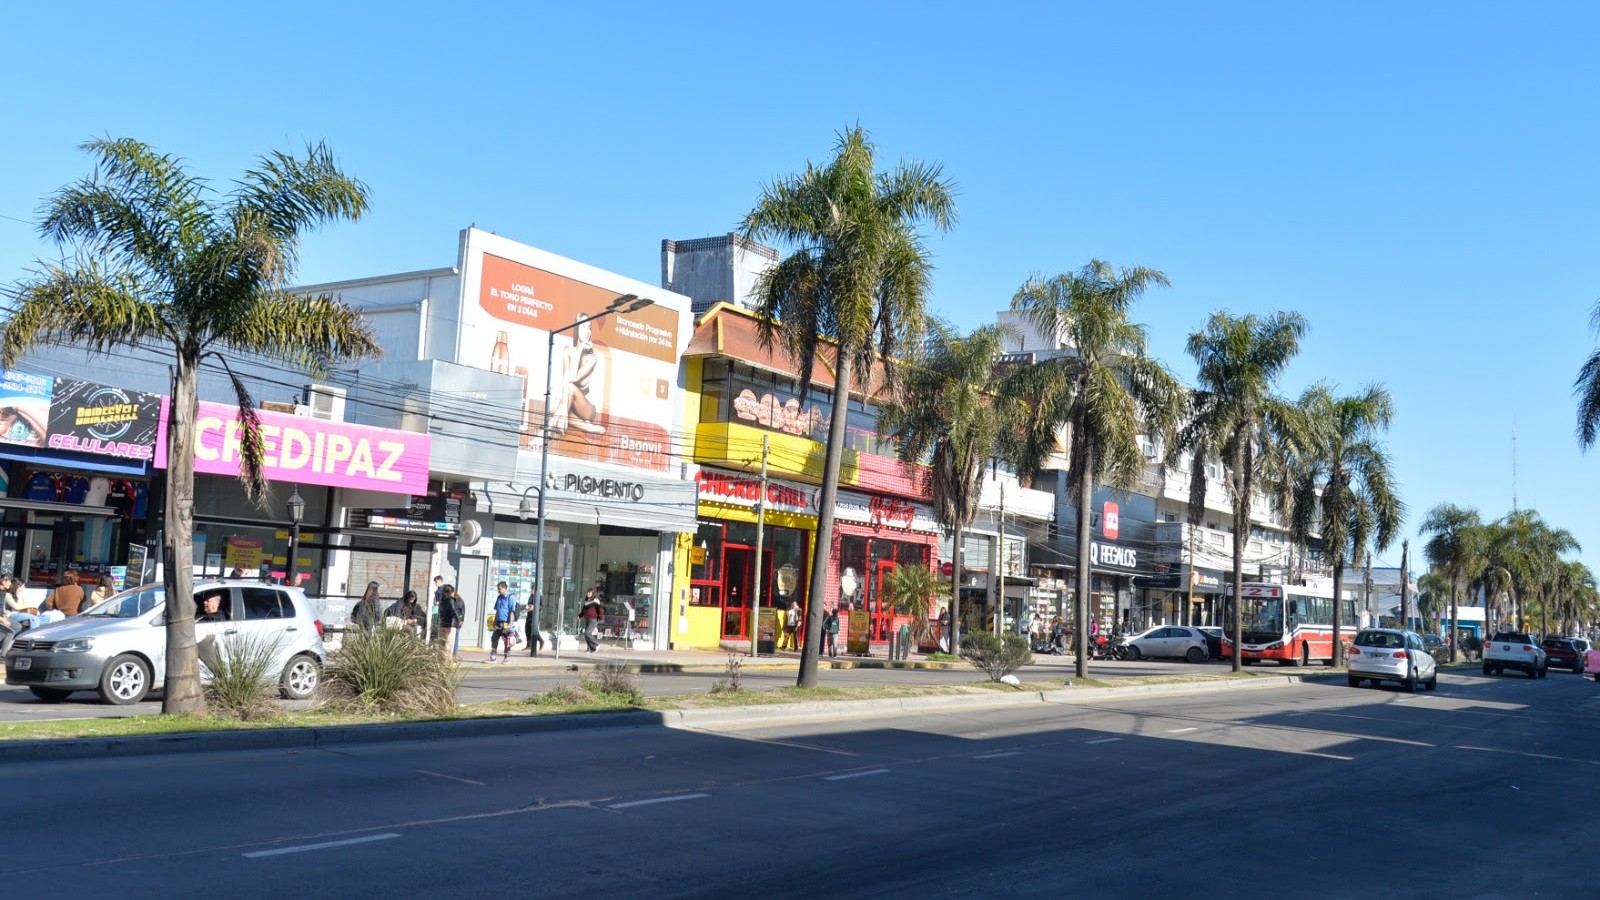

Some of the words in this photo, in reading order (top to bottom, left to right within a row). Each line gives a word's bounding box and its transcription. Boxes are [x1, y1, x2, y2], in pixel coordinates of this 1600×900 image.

[490, 287, 499, 297] EL
[500, 290, 520, 302] TONO
[520, 296, 553, 311] PERFECTO
[507, 303, 517, 312] EN
[517, 305, 522, 314] 3
[522, 306, 538, 317] DÍAS
[616, 315, 645, 331] Bronceado
[645, 323, 673, 339] Progresivo
[648, 336, 658, 345] por
[48, 433, 153, 459] CELULARES
[565, 473, 645, 502] PIGMENTO
[1100, 544, 1137, 569] REGALOS
